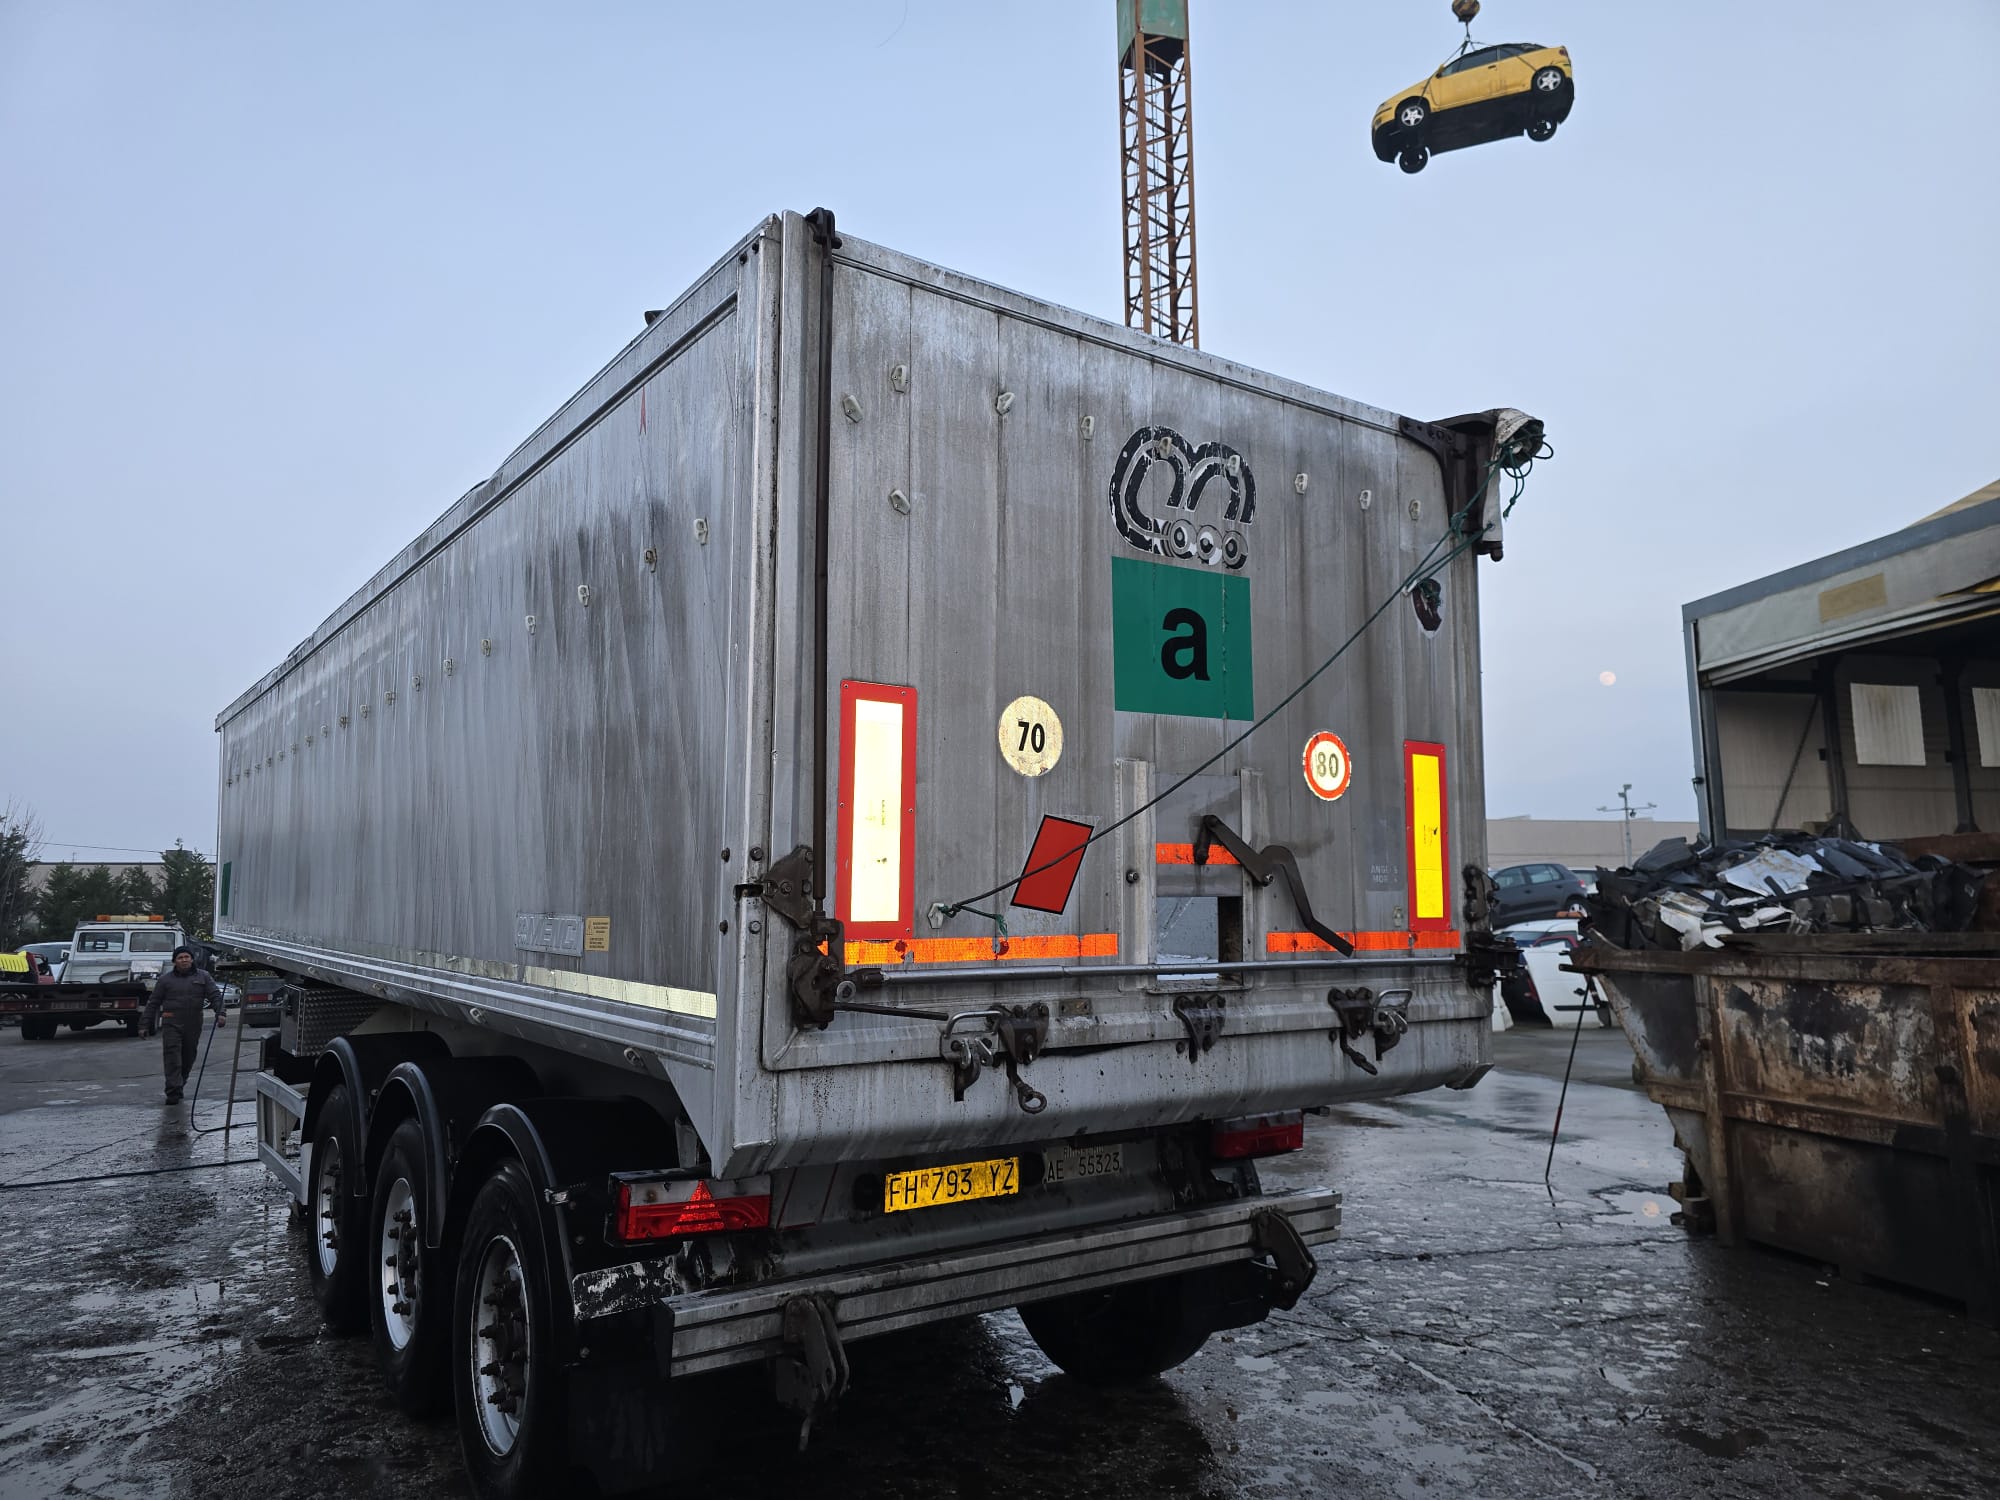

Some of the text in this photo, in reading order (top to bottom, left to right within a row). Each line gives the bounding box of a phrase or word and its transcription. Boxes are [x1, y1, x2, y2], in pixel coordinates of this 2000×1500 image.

[1160, 607, 1211, 681] a
[1017, 720, 1046, 754] 70
[1317, 751, 1339, 778] 80
[931, 1168, 973, 1201] 793
[989, 1161, 1016, 1190] YZ
[1047, 1153, 1121, 1181] AE 55323
